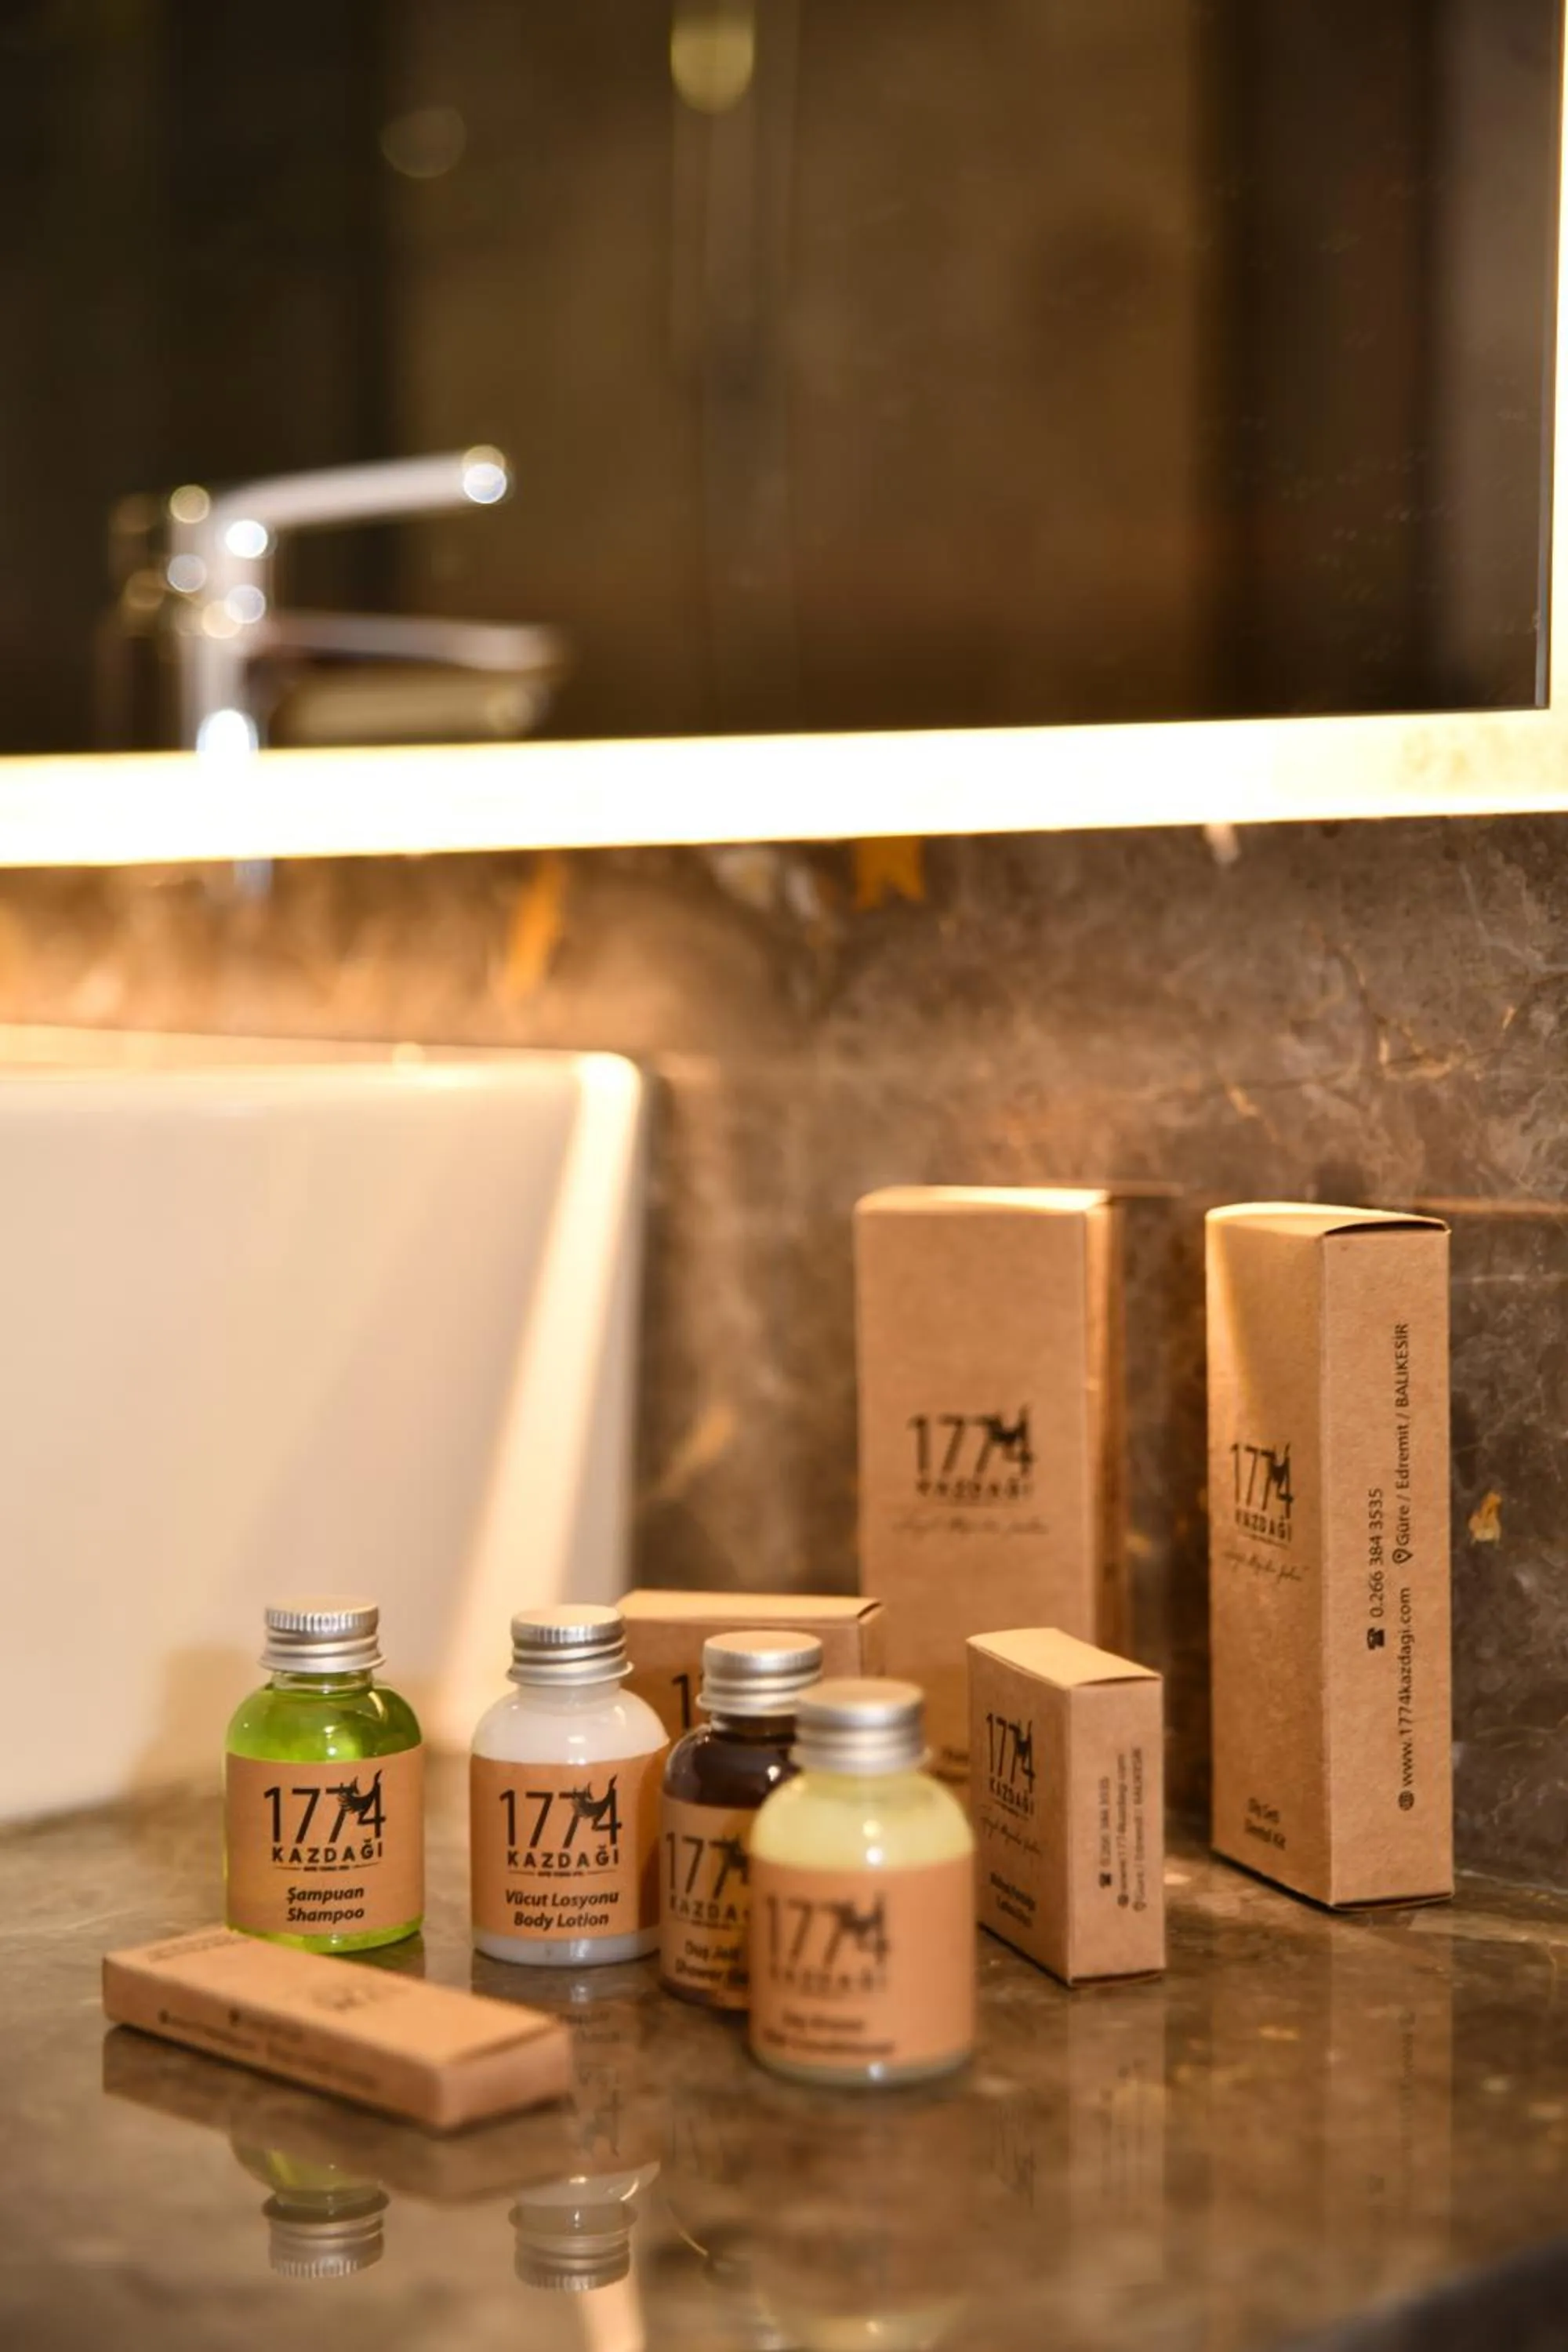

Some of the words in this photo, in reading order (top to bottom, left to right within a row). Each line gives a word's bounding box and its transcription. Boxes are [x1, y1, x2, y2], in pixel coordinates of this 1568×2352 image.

[907, 1404, 1036, 1479] 1774
[1395, 1424, 1410, 1490] Edremit
[1229, 1442, 1294, 1519] 1774
[1369, 1487, 1383, 1530] 3535
[1369, 1534, 1383, 1567] 384
[1370, 1570, 1384, 1618] 0.266
[1398, 1587, 1414, 1788] www.1774kazdagi.com
[986, 1712, 1036, 1794] 1774
[263, 1771, 387, 1844] 1774
[499, 1775, 622, 1849] 1774
[272, 1838, 383, 1864] KAZDAĞI
[507, 1845, 619, 1868] KAZDAĞI
[666, 1831, 749, 1900] 177
[287, 1886, 365, 1905] Şampuan
[287, 1907, 365, 1924] Shampoo
[506, 1889, 547, 1907] Vücut
[552, 1891, 619, 1909] Losyonu
[670, 1894, 750, 1921] KAZDA
[514, 1911, 554, 1931] Body
[557, 1913, 609, 1928] Lotion
